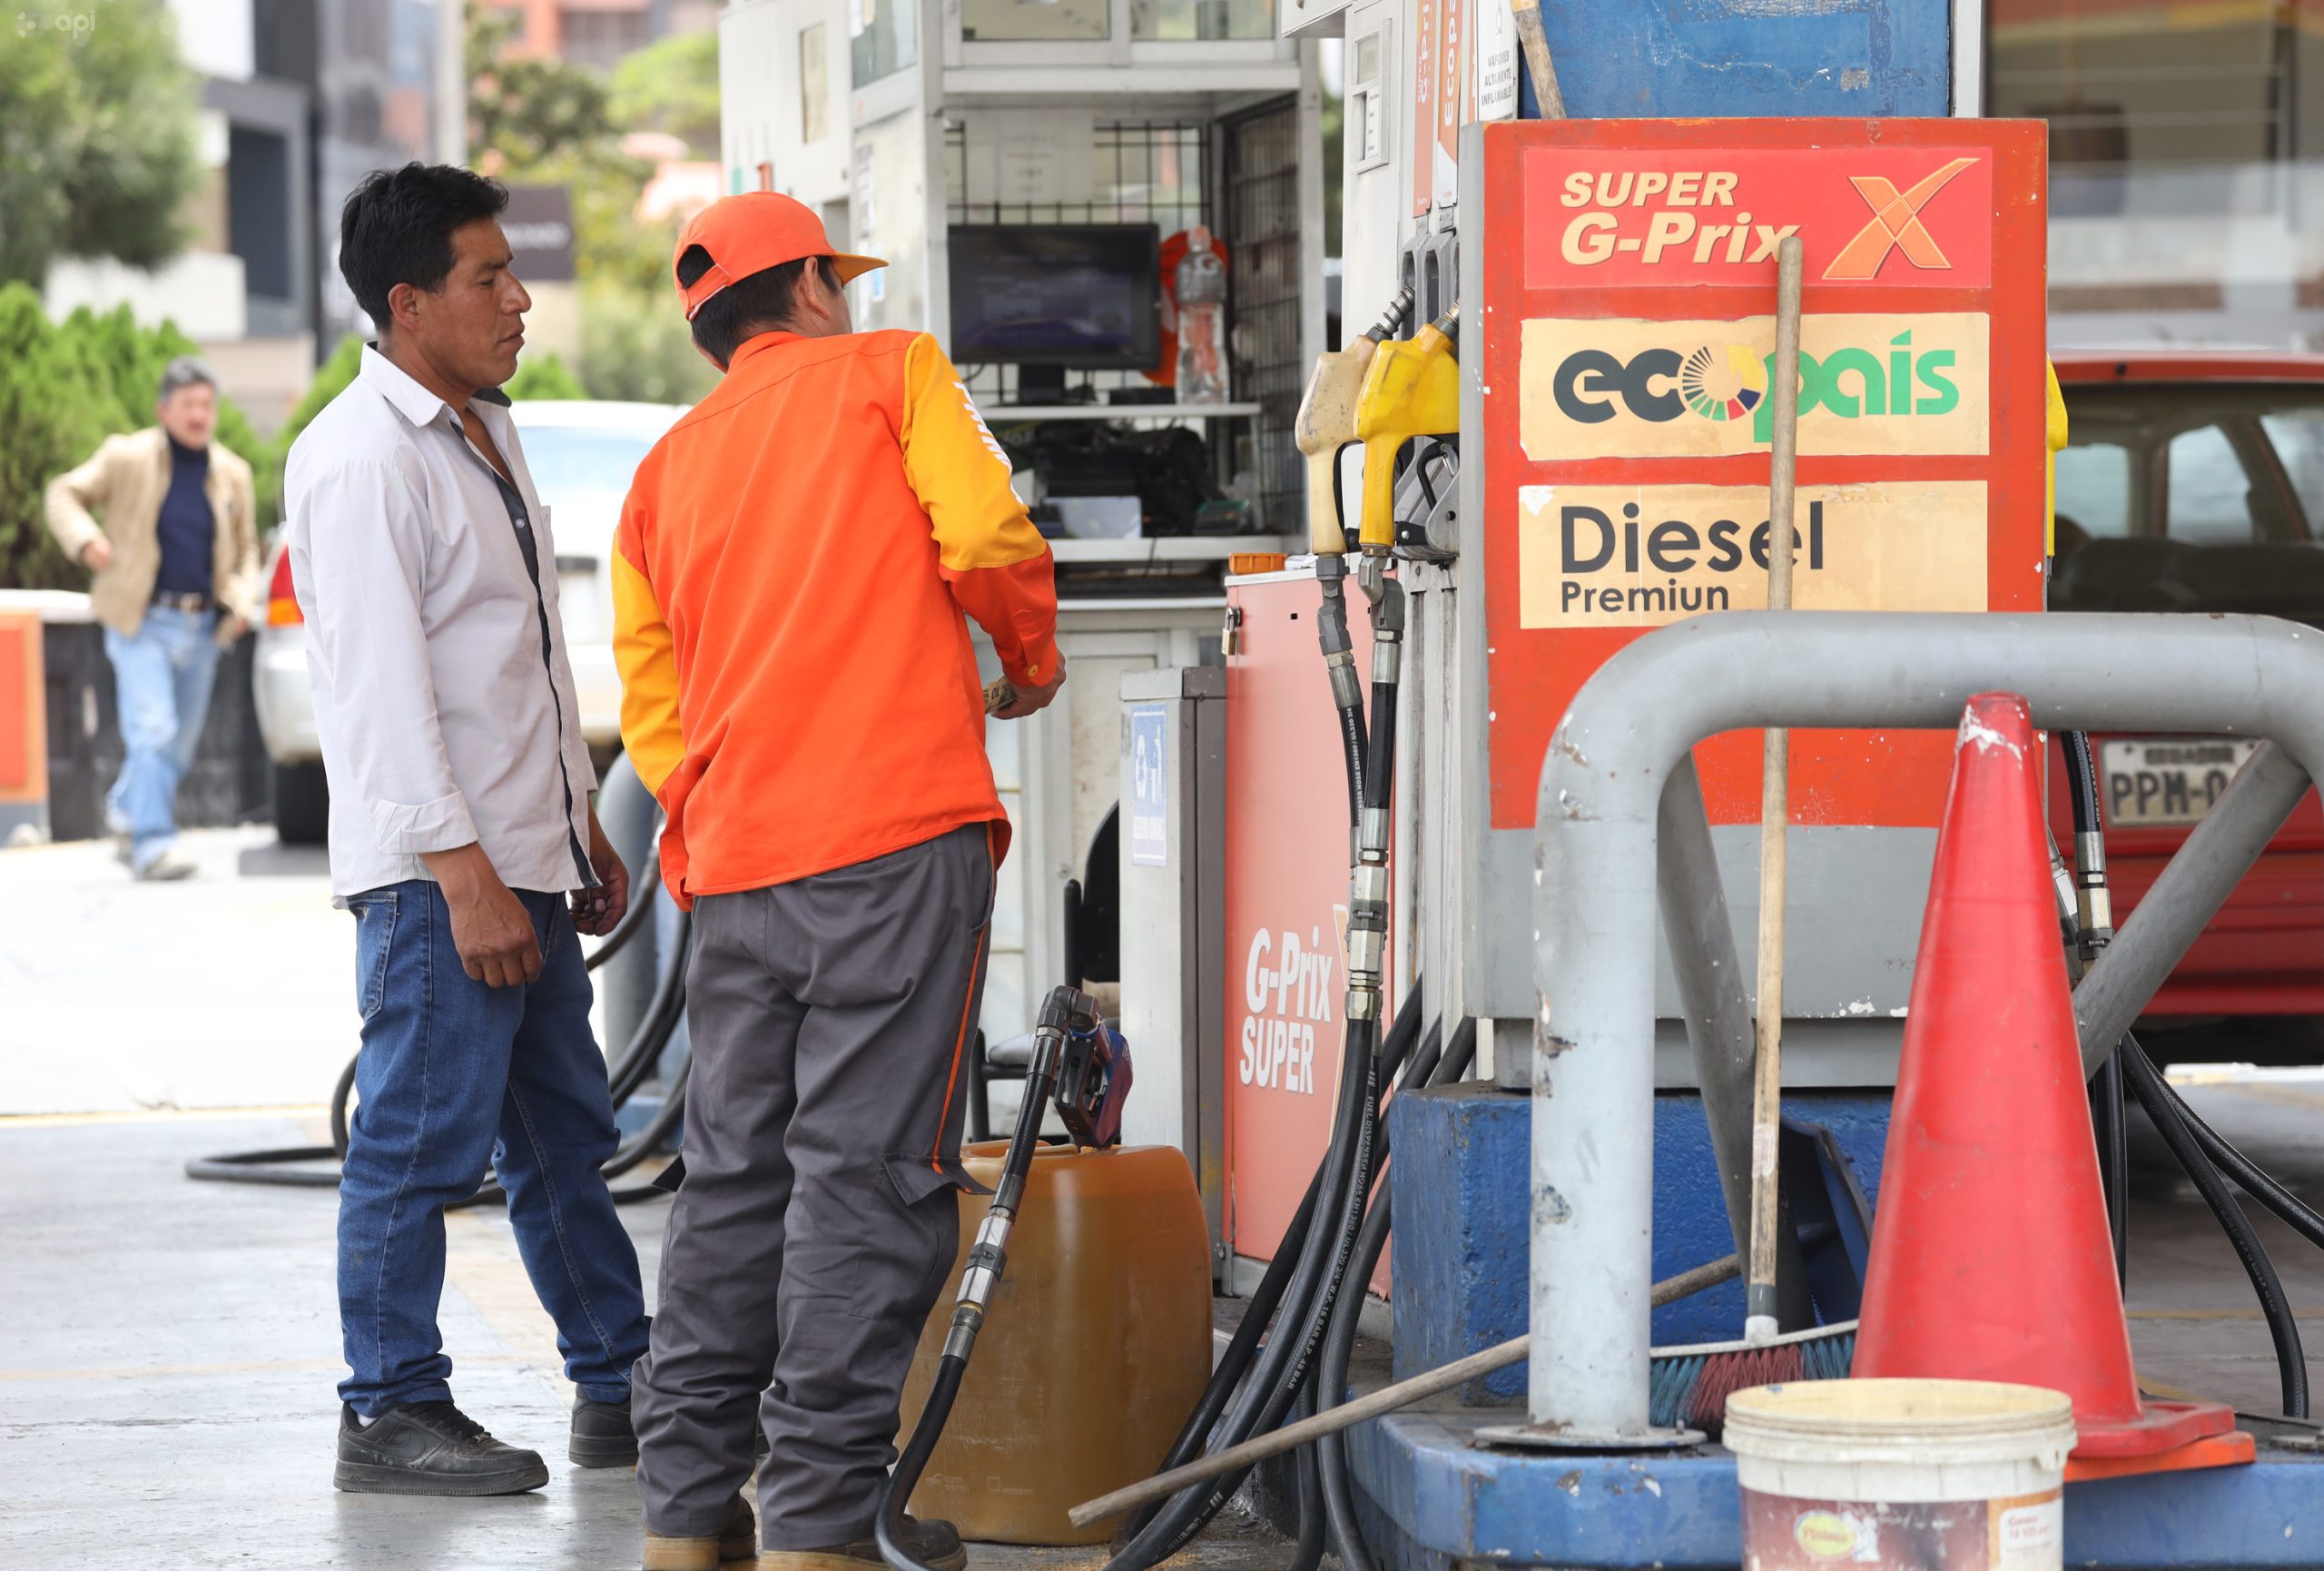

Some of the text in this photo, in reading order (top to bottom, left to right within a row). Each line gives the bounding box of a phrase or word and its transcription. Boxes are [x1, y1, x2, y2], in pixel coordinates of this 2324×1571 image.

[1560, 171, 1739, 208] SUPER
[1560, 212, 1801, 264] G-Prix
[1561, 501, 1824, 574] Diesel
[1561, 578, 1728, 613] Premiun
[1246, 925, 1334, 1022] G-Prix
[1240, 1015, 1315, 1095] SUPER
[1312, 1319, 1324, 1338] BAR
[1287, 1371, 1301, 1389] BAR
